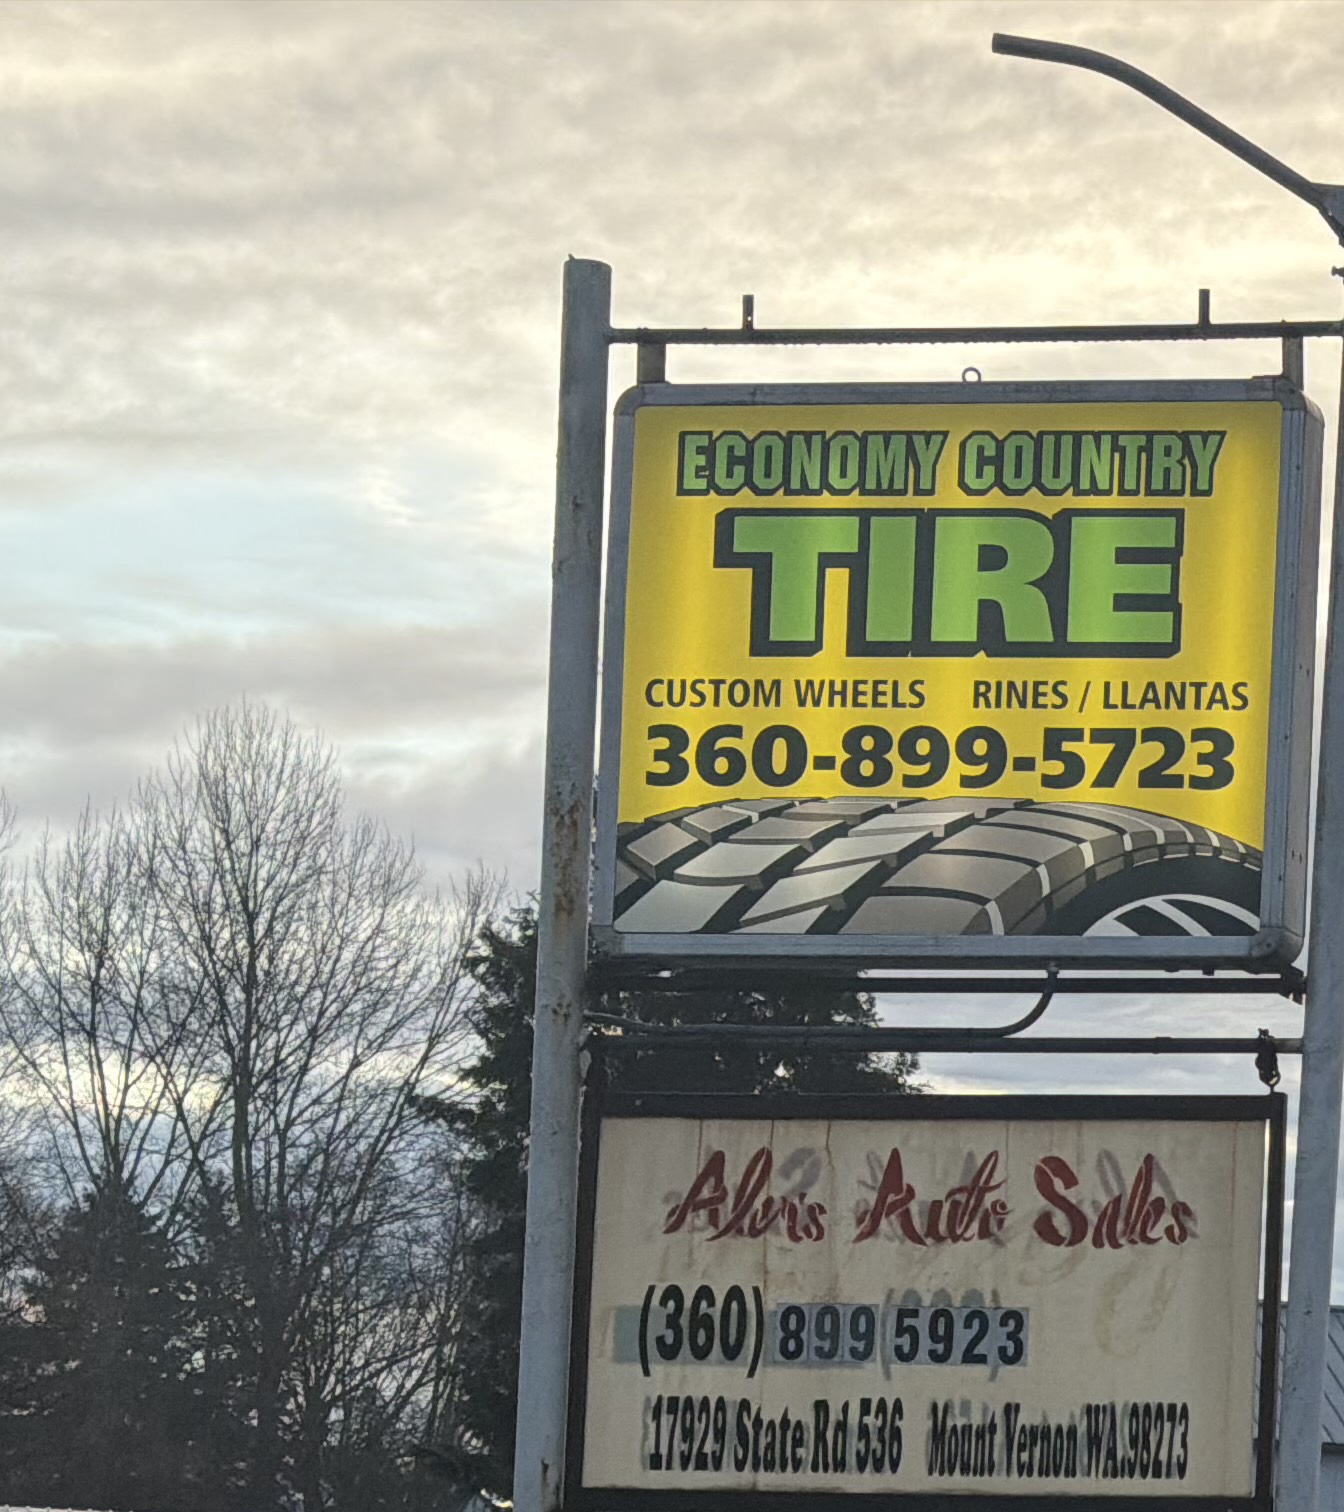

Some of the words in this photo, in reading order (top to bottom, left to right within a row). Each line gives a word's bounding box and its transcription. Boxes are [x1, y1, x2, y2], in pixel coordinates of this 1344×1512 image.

[676, 430, 949, 496] ECONOMY
[957, 430, 1227, 496] COUNTRY
[712, 508, 1185, 658] TIRE
[645, 679, 781, 709] CUSTOM
[794, 679, 926, 710] WHEELS
[972, 680, 1070, 711] RINES
[1102, 681, 1250, 712] LLANTAS
[645, 724, 1236, 791] 360-899-5723
[852, 1147, 1008, 1247] Auto
[1033, 1153, 1196, 1249] Sales
[638, 1284, 764, 1378] (360)
[778, 1305, 877, 1362] 899
[894, 1307, 1025, 1366] 5923
[649, 1394, 728, 1472] 17929
[733, 1397, 805, 1474] State
[810, 1399, 850, 1474] Rd
[855, 1397, 904, 1475] 536
[928, 1401, 997, 1477] Mount
[1004, 1401, 1078, 1479] Vernon
